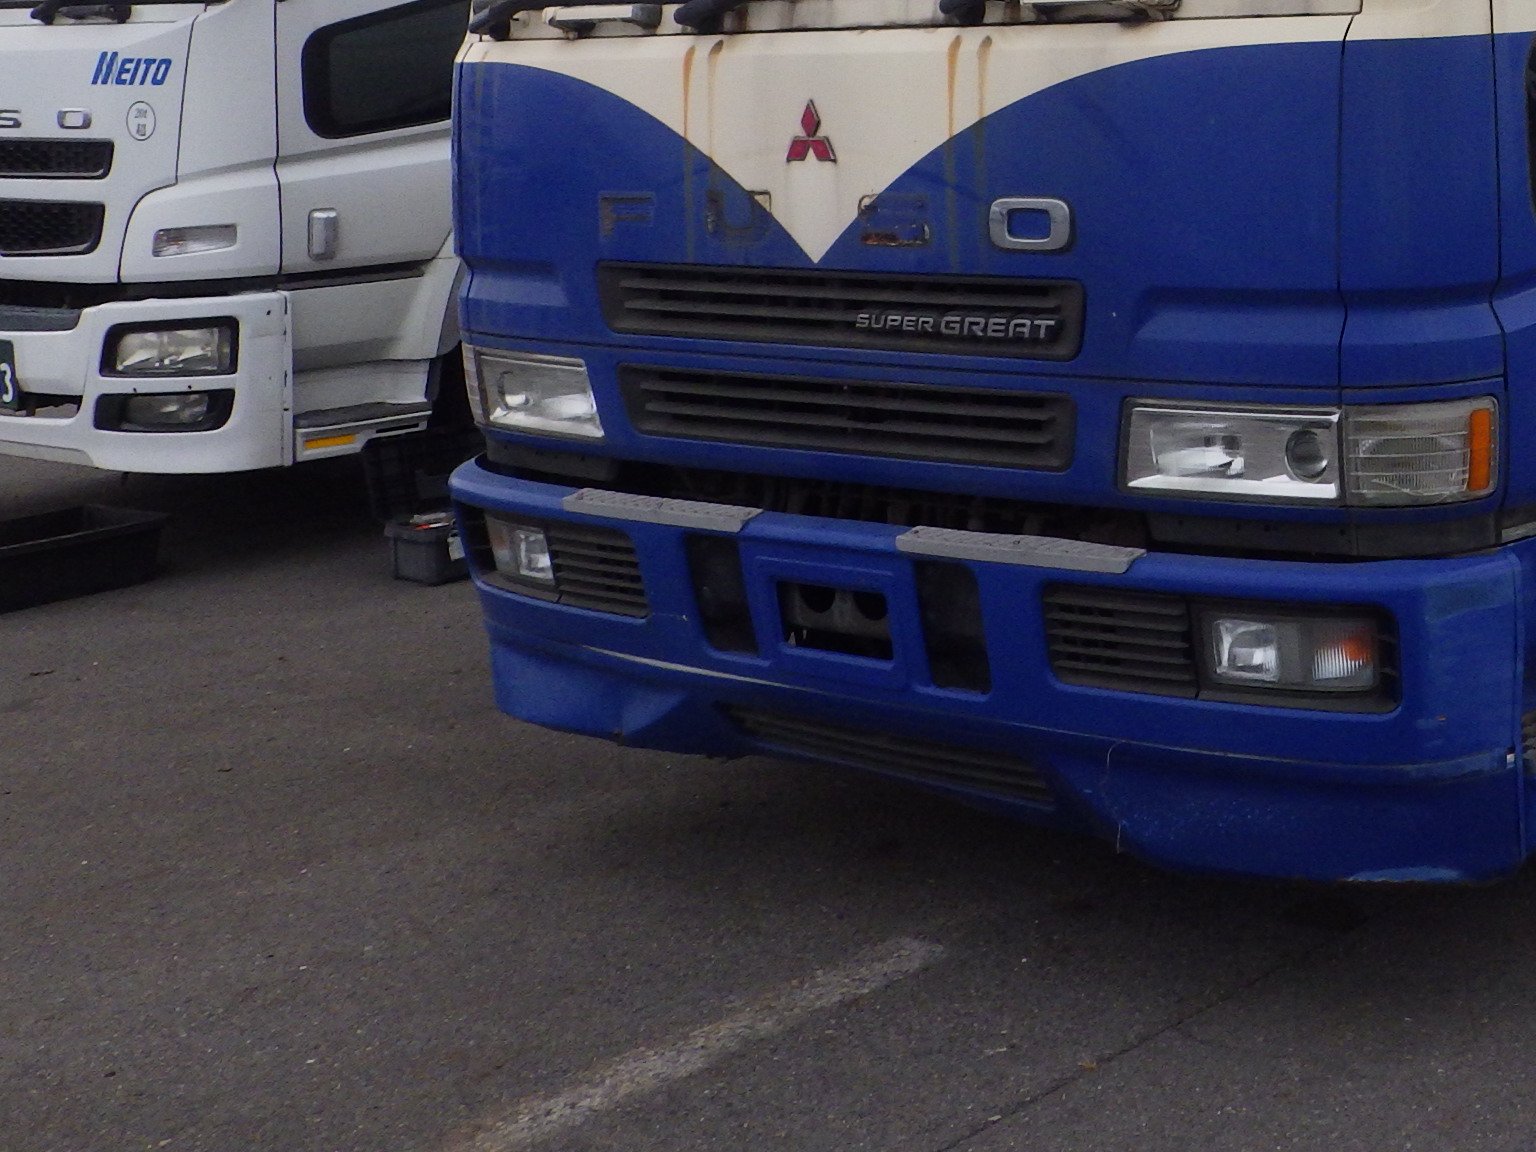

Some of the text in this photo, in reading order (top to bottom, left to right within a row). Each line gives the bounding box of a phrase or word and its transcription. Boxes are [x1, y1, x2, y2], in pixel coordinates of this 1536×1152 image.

[91, 51, 172, 86] MEITO
[856, 313, 1056, 339] SUPER GREAT
